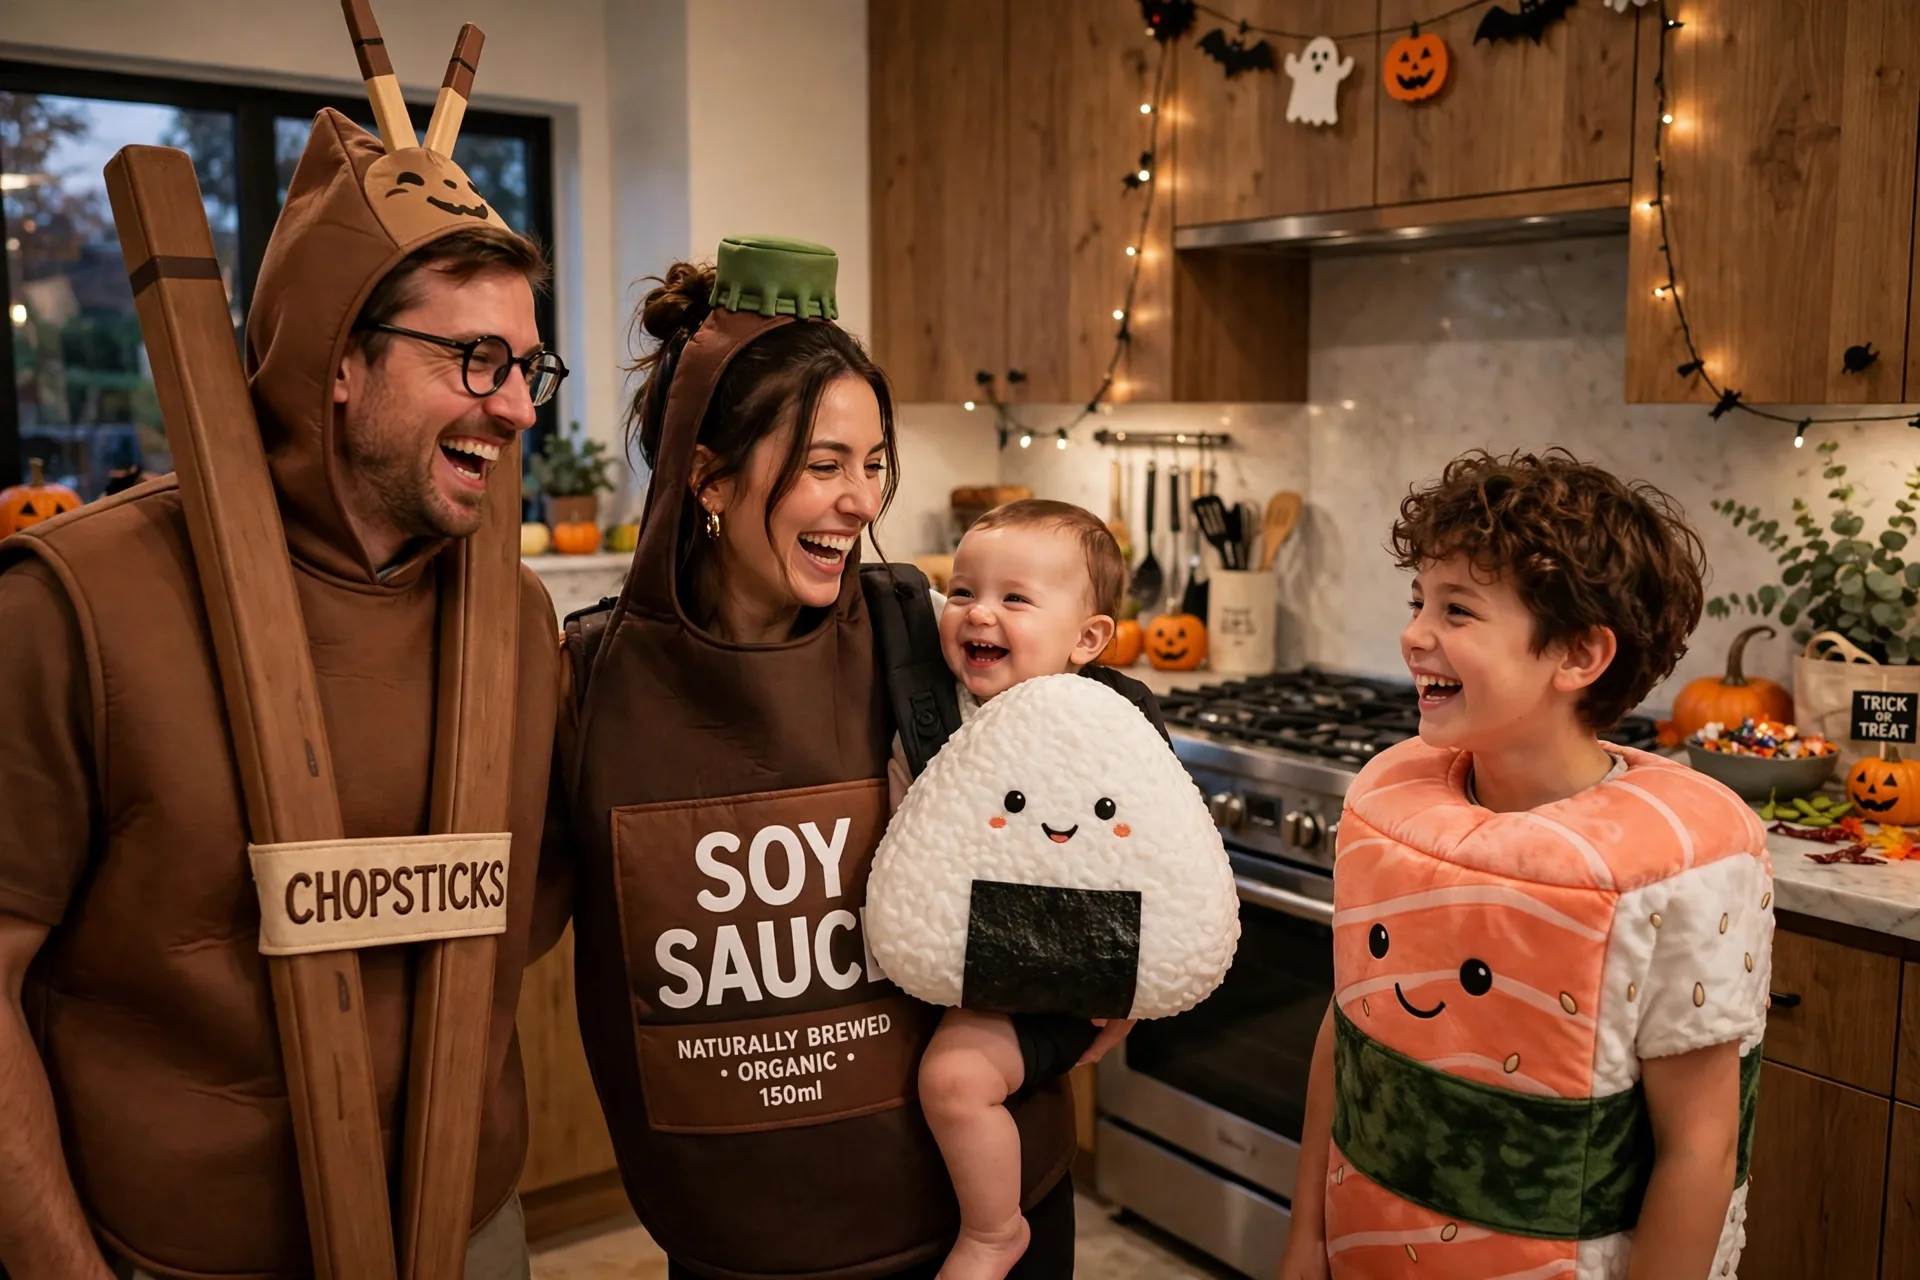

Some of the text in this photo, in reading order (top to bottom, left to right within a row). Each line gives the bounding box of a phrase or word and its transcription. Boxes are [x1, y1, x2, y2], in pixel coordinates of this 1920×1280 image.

[1861, 695, 1908, 711] TRICK
[1875, 711, 1892, 722] OR
[1859, 722, 1909, 739] TREAT
[695, 817, 851, 913] SOY
[285, 860, 505, 925] CHOPSTICKS
[677, 1013, 891, 1060] NATURALLY BREWED
[737, 1051, 837, 1082] ORGANIC
[759, 1080, 823, 1107] 150ml
